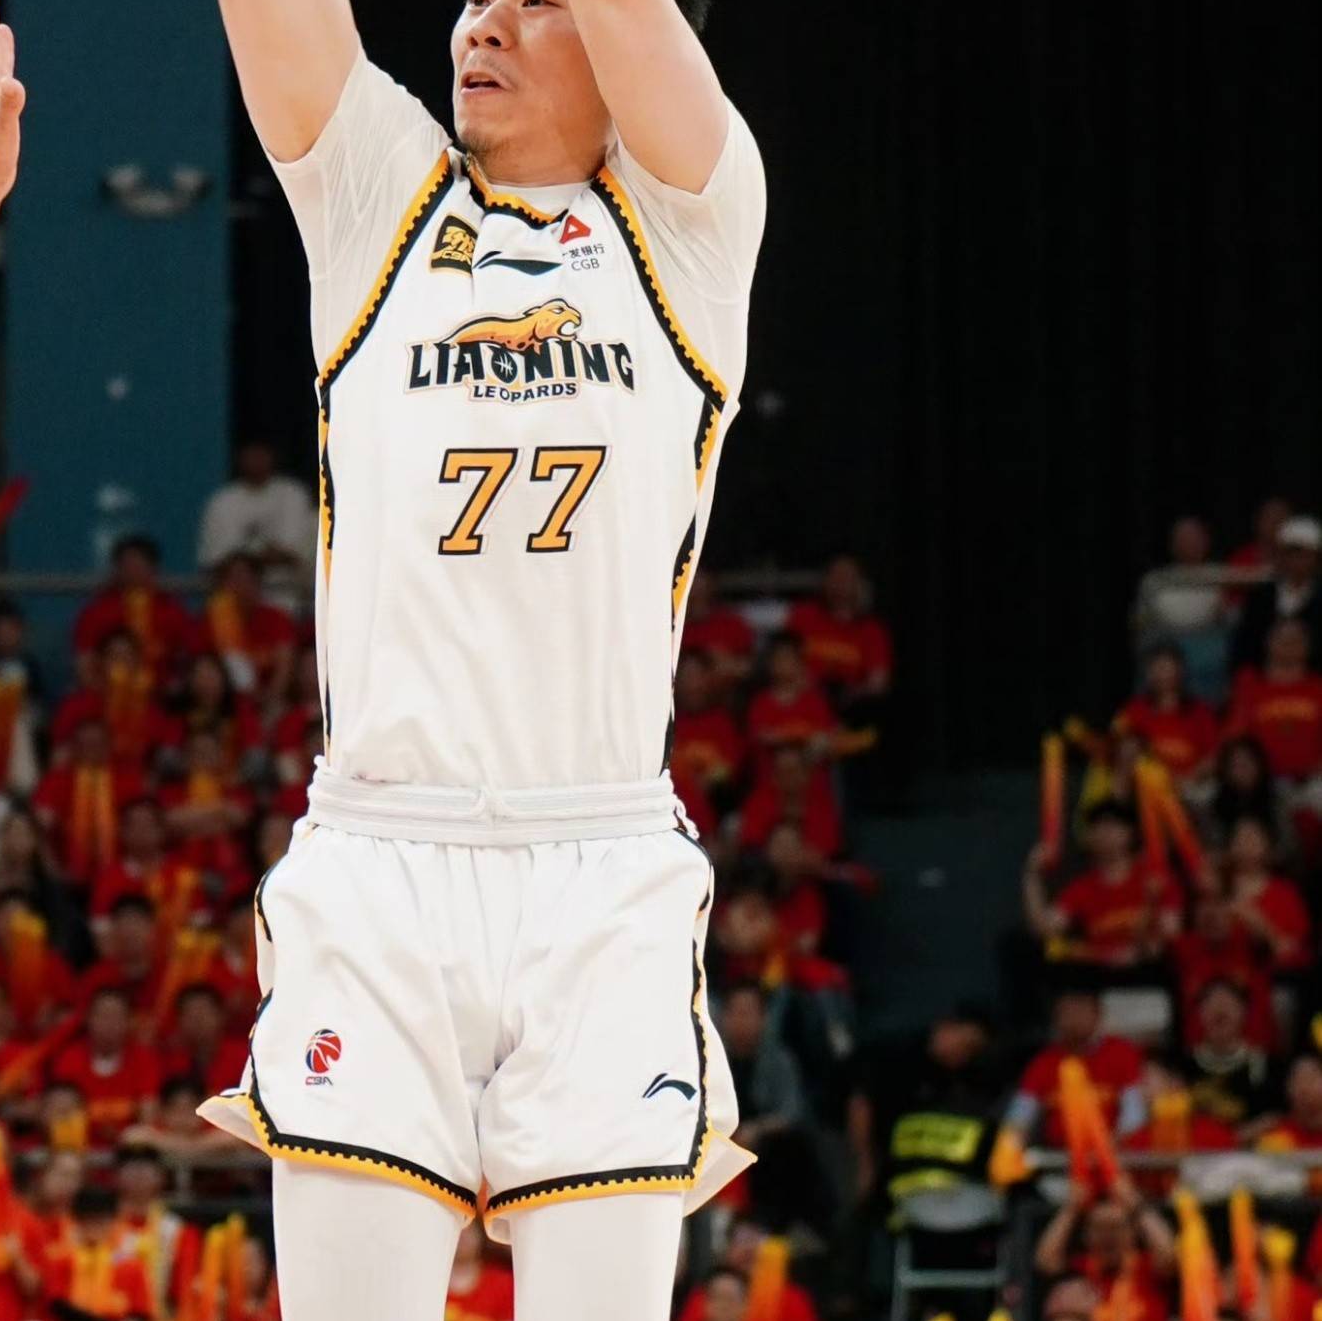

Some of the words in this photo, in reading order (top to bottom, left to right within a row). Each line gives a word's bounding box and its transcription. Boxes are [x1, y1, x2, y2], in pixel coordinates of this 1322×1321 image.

[571, 259, 600, 271] CGB
[409, 340, 635, 391] LIAONING
[473, 381, 577, 402] LEOPARDS
[438, 445, 609, 555] 77
